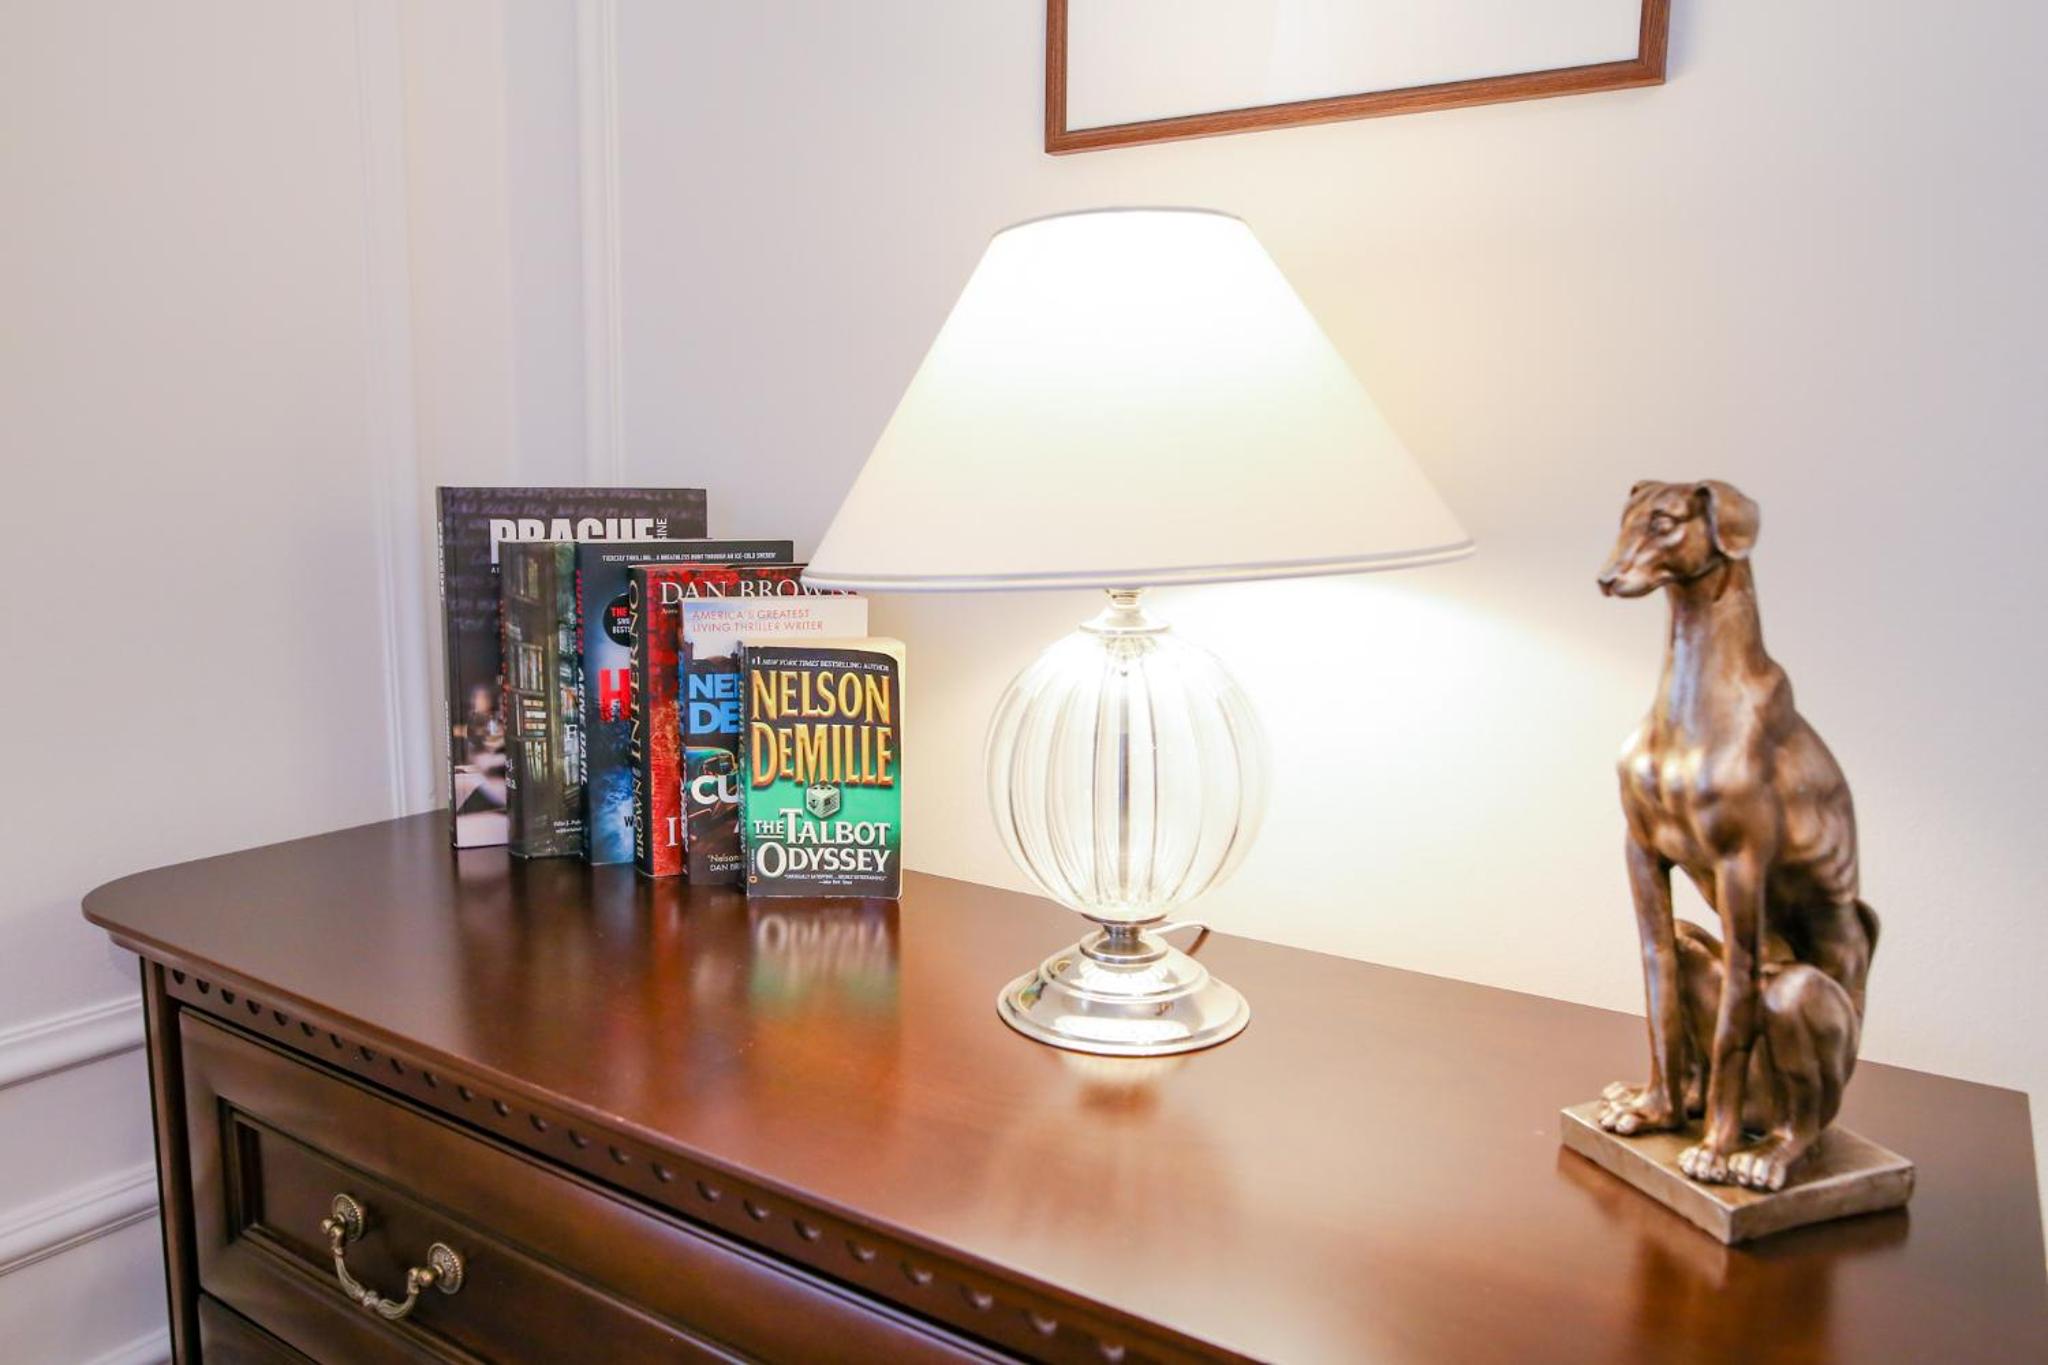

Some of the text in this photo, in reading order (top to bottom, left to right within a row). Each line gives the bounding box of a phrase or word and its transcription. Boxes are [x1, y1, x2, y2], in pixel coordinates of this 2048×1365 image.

[660, 581, 726, 605] DAN
[611, 606, 629, 618] THE
[693, 621, 823, 633] LIVING THRILLER WRITER
[757, 608, 810, 619] GREATEST
[762, 658, 778, 666] NEW
[820, 660, 861, 669] BESTSELLING
[863, 663, 889, 671] AUTHOR
[751, 669, 891, 725] NELSON
[629, 579, 644, 859] BROWN INFERNO
[579, 731, 588, 786] DAHL
[754, 819, 784, 834] THE
[779, 808, 891, 846] TALBOT
[756, 841, 891, 878] ODYSSEY
